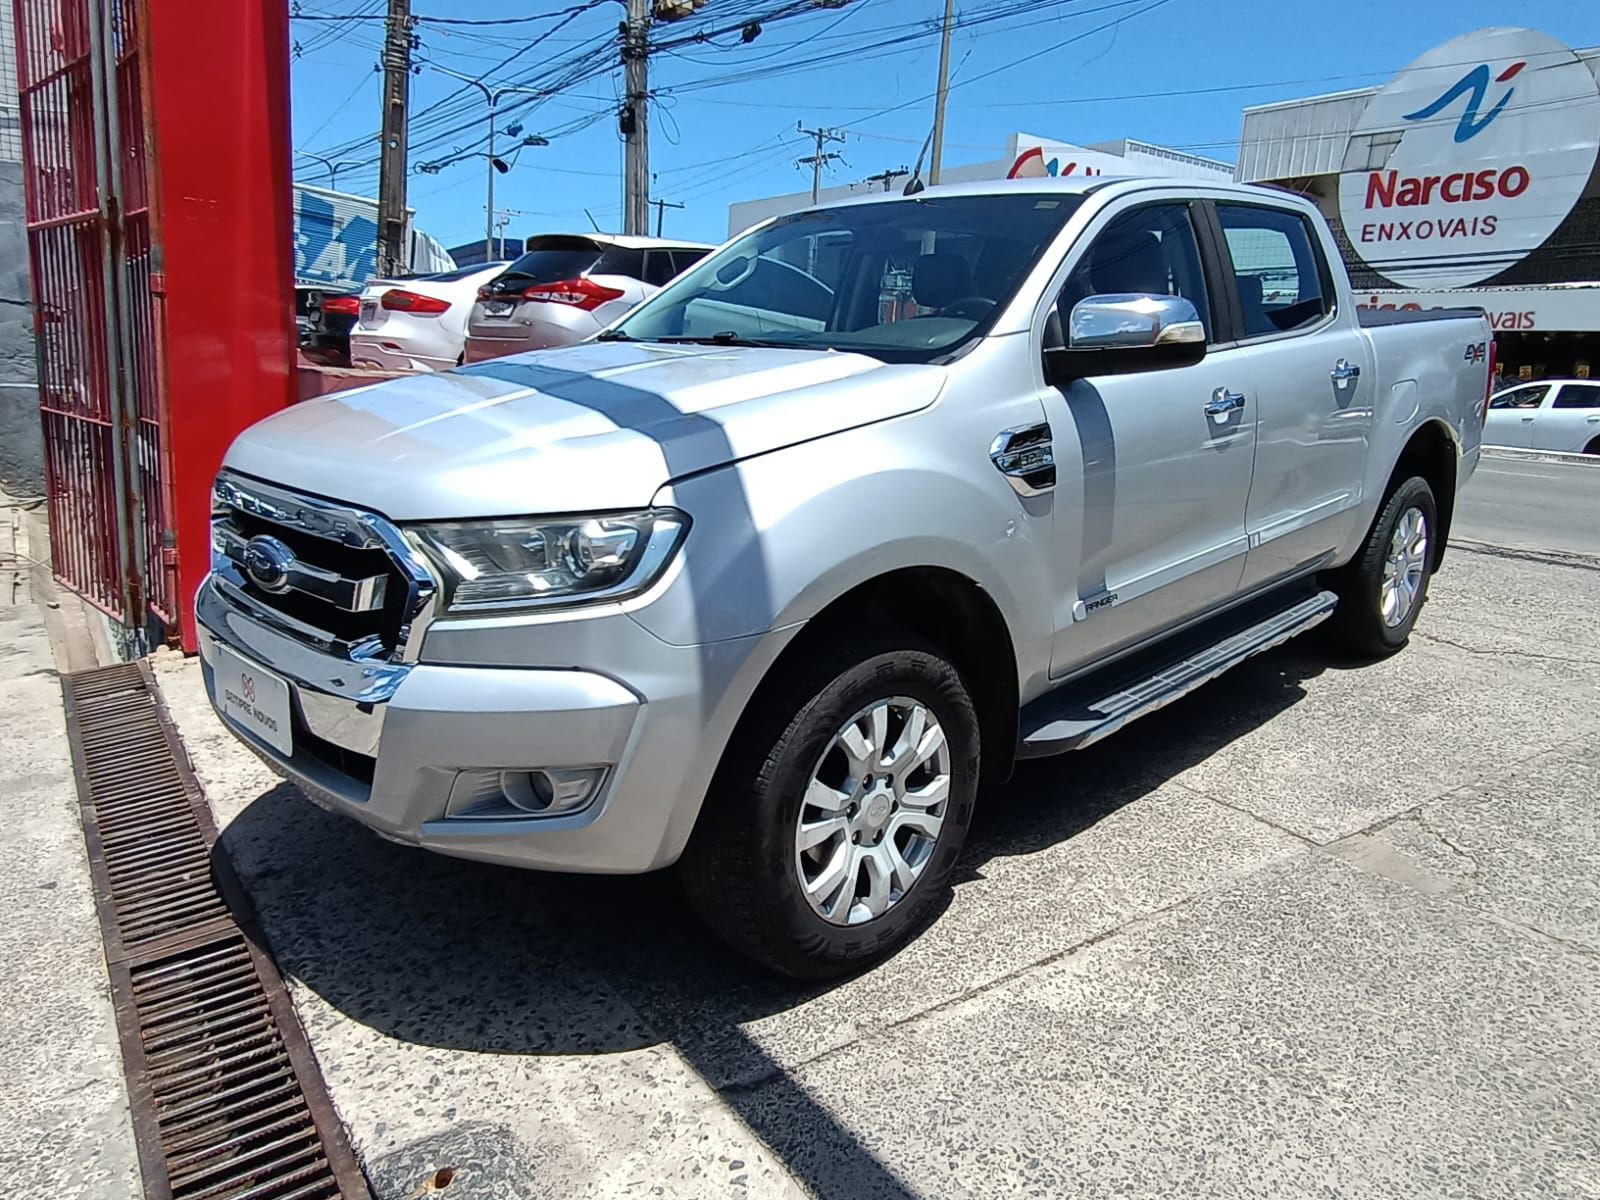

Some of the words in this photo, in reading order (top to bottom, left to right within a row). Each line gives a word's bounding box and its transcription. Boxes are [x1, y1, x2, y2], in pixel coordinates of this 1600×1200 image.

[1364, 166, 1530, 209] Narciso
[1361, 215, 1498, 242] ENXOVAIS
[1486, 310, 1536, 329] vais
[1085, 593, 1118, 613] RANGER
